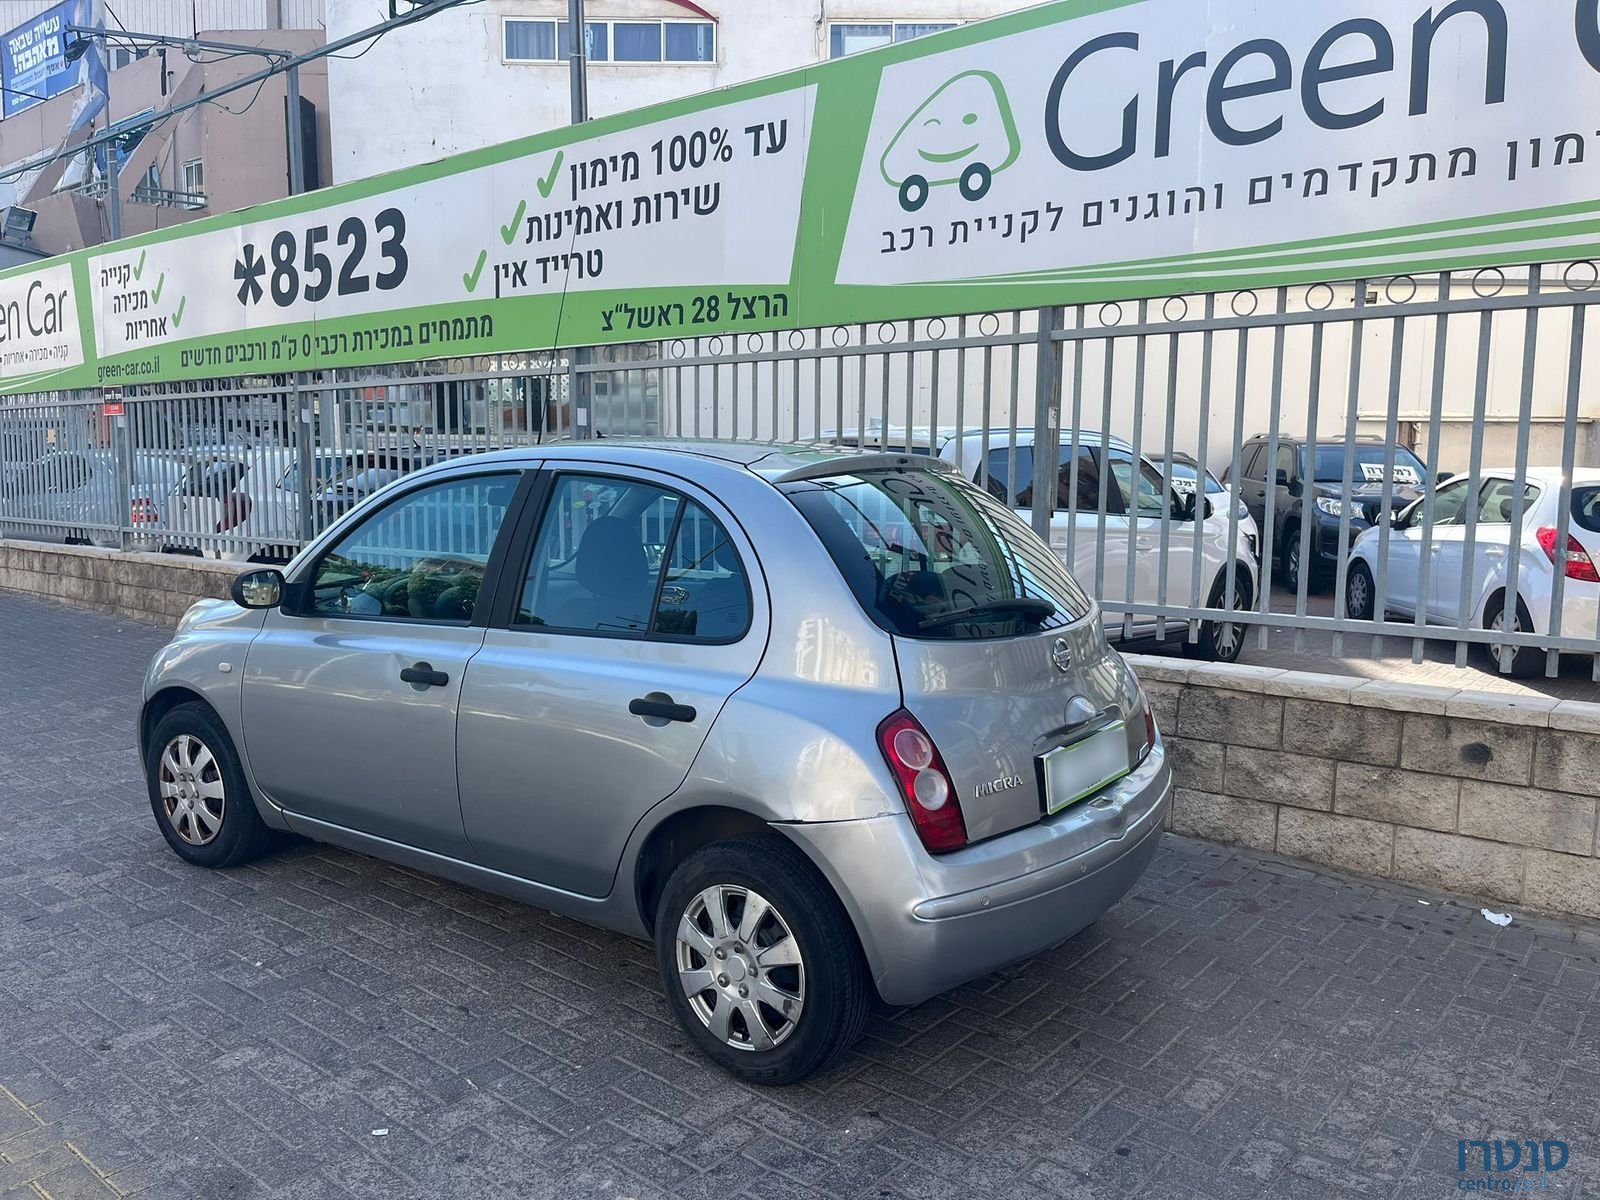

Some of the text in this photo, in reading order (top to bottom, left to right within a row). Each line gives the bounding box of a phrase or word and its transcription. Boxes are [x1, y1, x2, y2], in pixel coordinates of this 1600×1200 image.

[13, 36, 60, 75] מאהבה!
[1045, 0, 1508, 171] Green
[570, 119, 788, 201] עד 100% מימון
[881, 131, 1600, 254] מון מתקדמים והוגנים לקניית רכב
[525, 182, 720, 244] שירות ואמינות
[101, 264, 131, 289] קנייה
[493, 249, 603, 299] טרייד אין
[26, 280, 68, 338] Car
[113, 290, 149, 314] מכירה
[691, 297, 720, 323] 28
[726, 292, 788, 321] הרצל
[125, 317, 168, 341] אחריות
[352, 325, 414, 351] במכירת
[418, 314, 494, 344] מתמחים
[181, 346, 221, 368] חדשים
[225, 341, 267, 364] ורכבים
[302, 333, 311, 358] 0
[315, 333, 348, 356] רכבי
[97, 355, 160, 382] green-car.co.il
[974, 774, 1023, 799] MICRA
